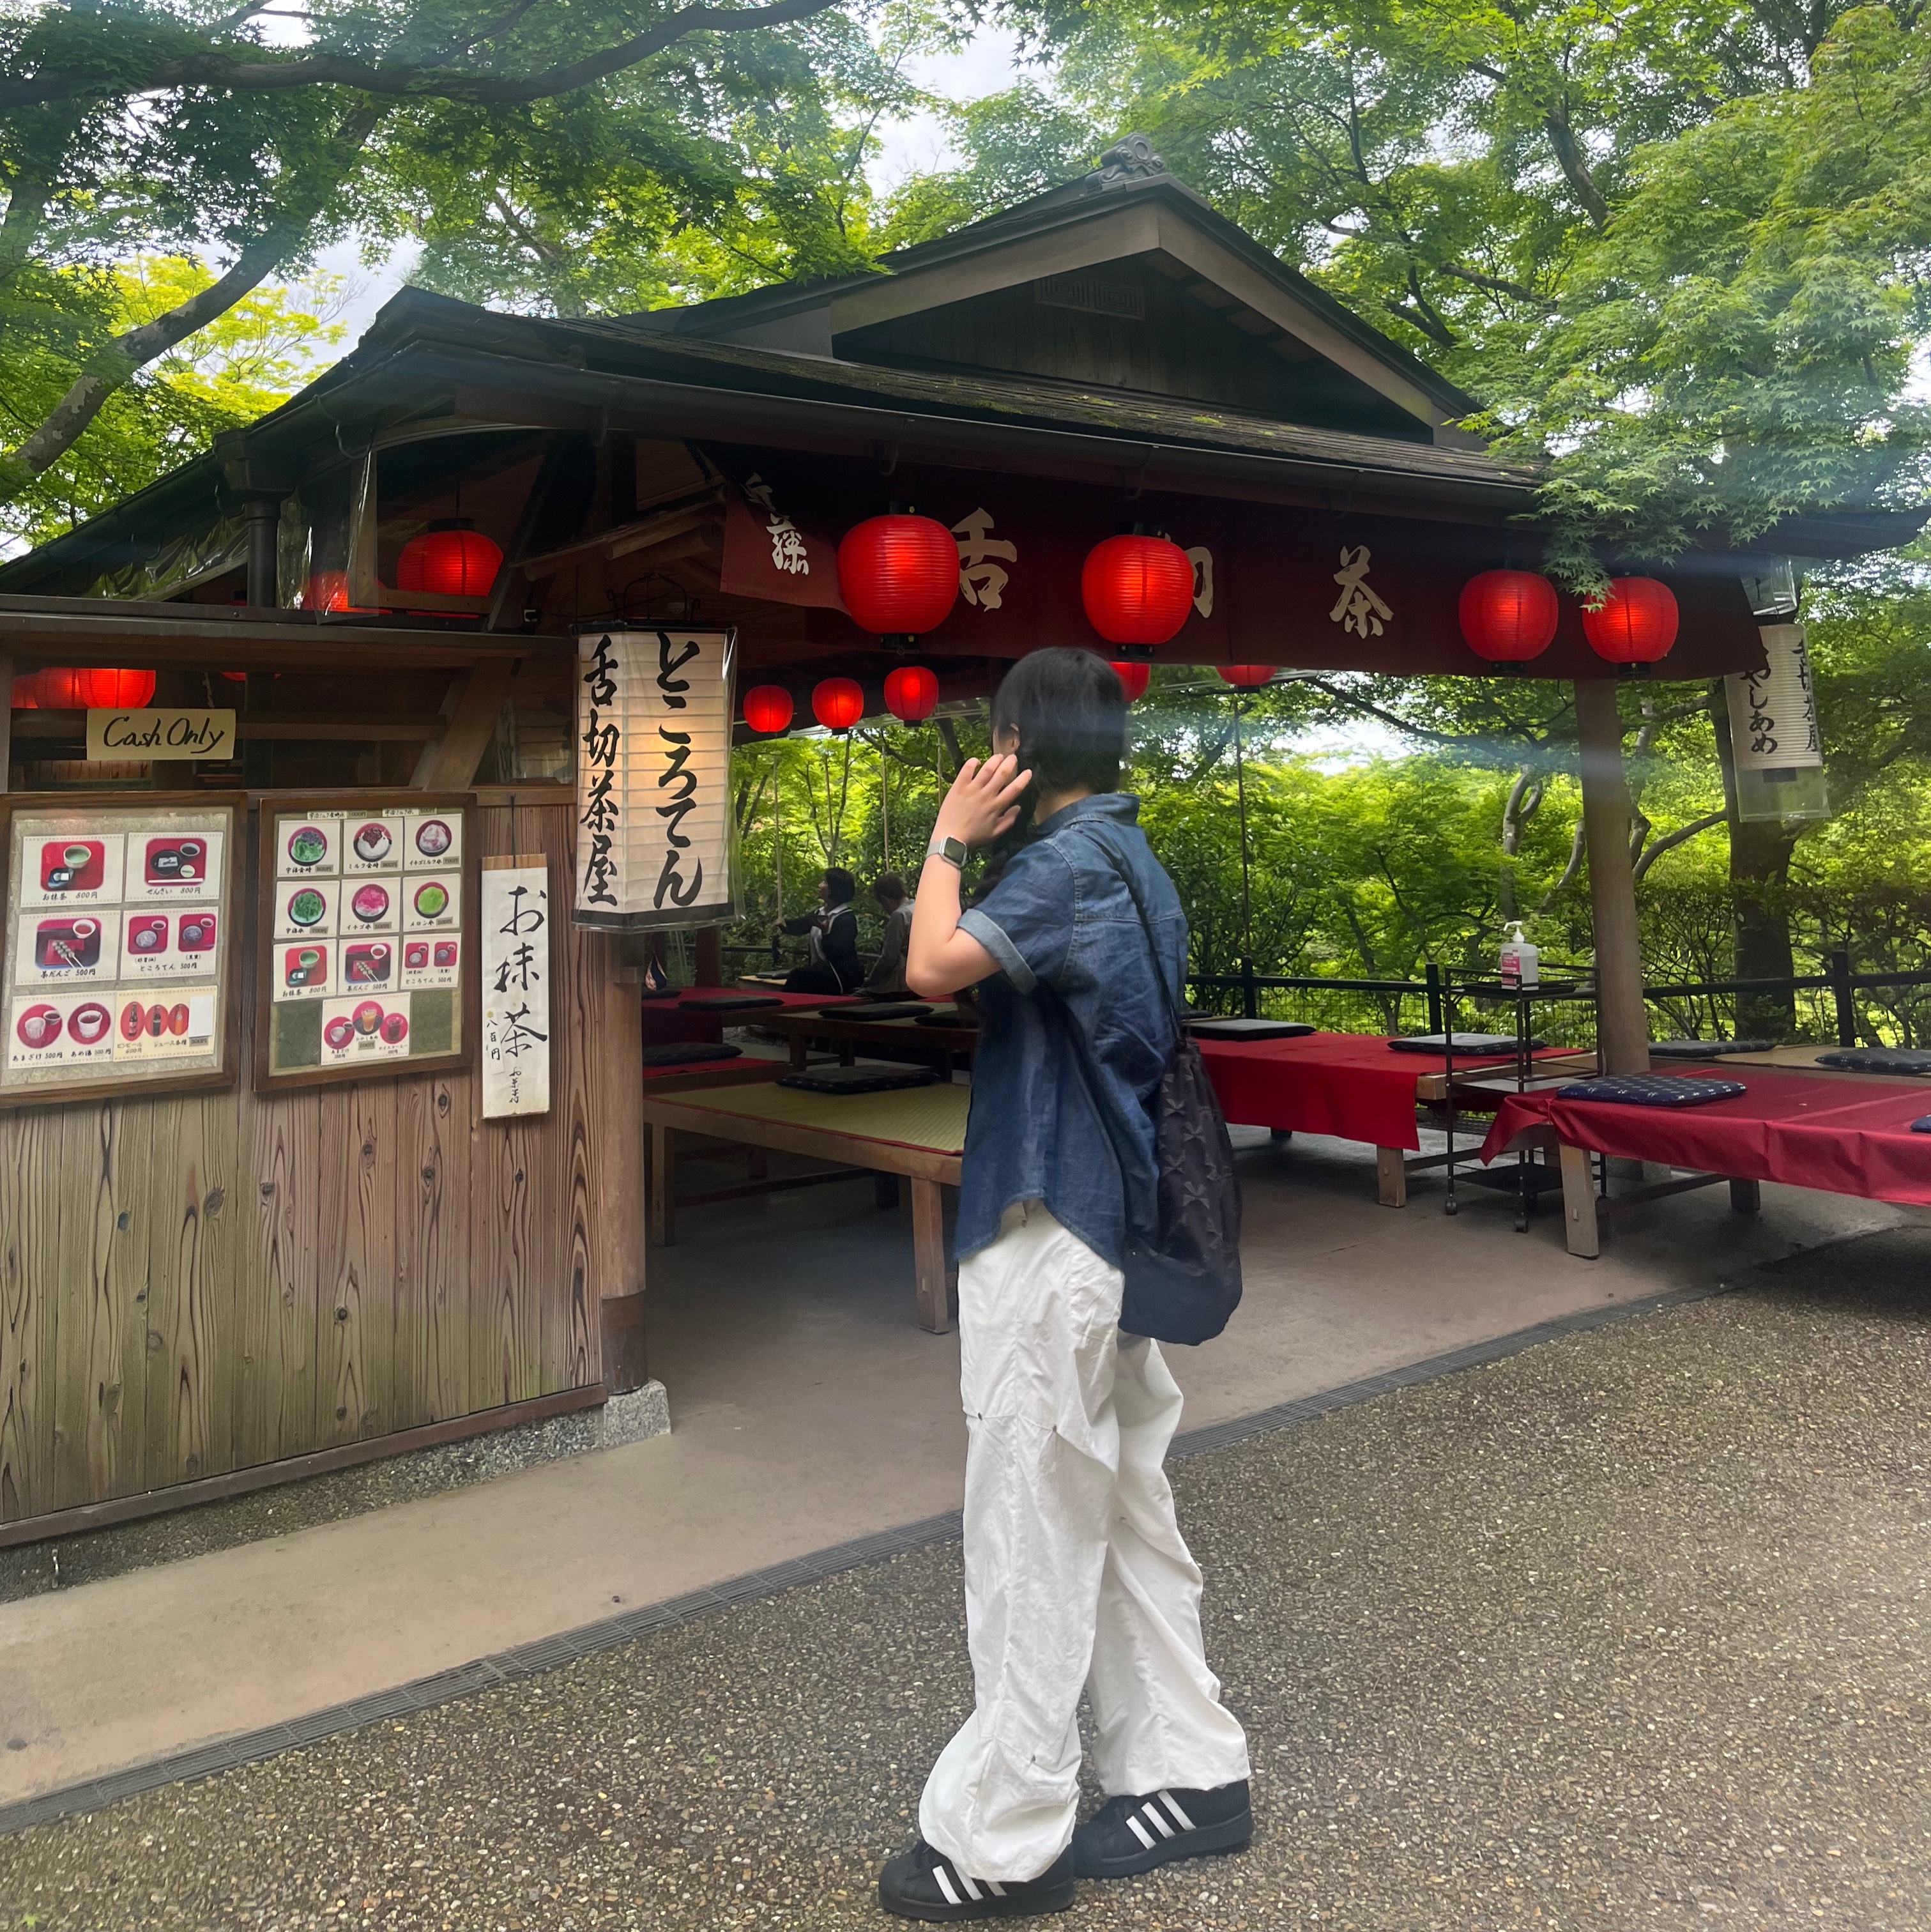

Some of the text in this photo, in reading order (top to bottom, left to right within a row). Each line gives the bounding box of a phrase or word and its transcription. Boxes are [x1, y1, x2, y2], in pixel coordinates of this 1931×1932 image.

[1739, 648, 1778, 755] やしあめ
[103, 716, 225, 754] Cash Only
[579, 634, 620, 907] 舌切茶屋
[653, 631, 703, 910] ところてん
[42, 893, 68, 901] お抹茶
[40, 969, 70, 978] 茶だんご
[139, 963, 176, 972] ところてん
[494, 885, 548, 1058] お抹茶
[12, 1051, 63, 1062] あまざけ 500円
[486, 1020, 500, 1061] 八百円
